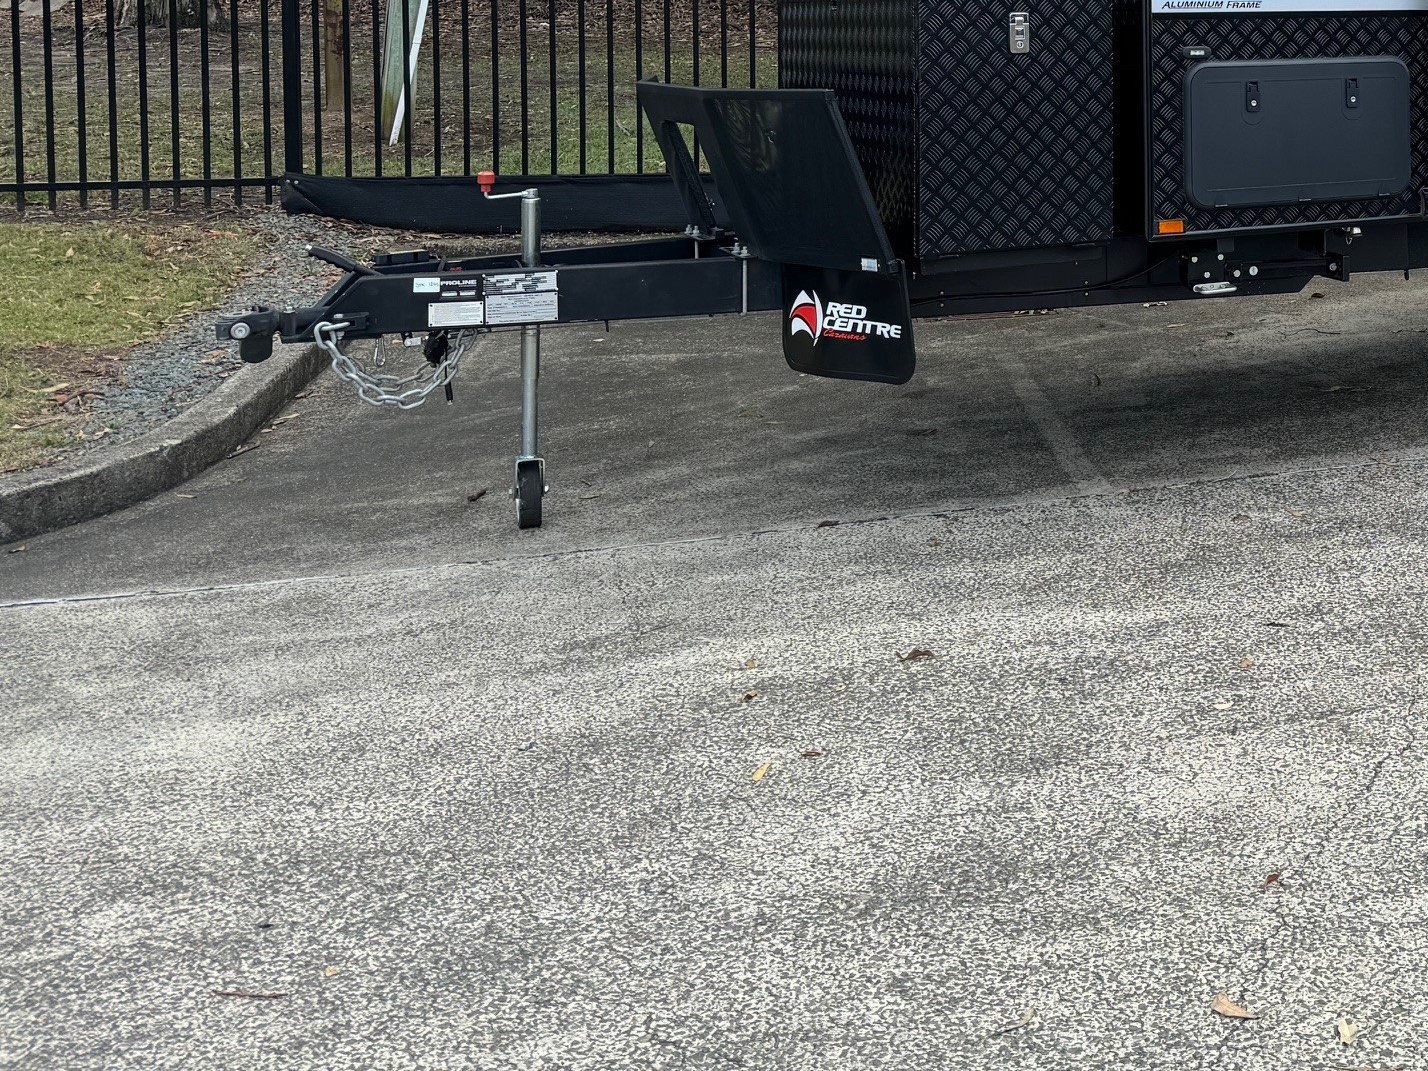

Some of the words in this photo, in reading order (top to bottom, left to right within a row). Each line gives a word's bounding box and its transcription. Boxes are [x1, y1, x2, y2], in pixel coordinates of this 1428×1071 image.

[1161, 0, 1223, 10] ALUMINIUM
[1226, 0, 1263, 9] FRAME
[440, 279, 477, 287] PROLINE
[826, 301, 867, 319] RED
[822, 317, 902, 339] CENTRE
